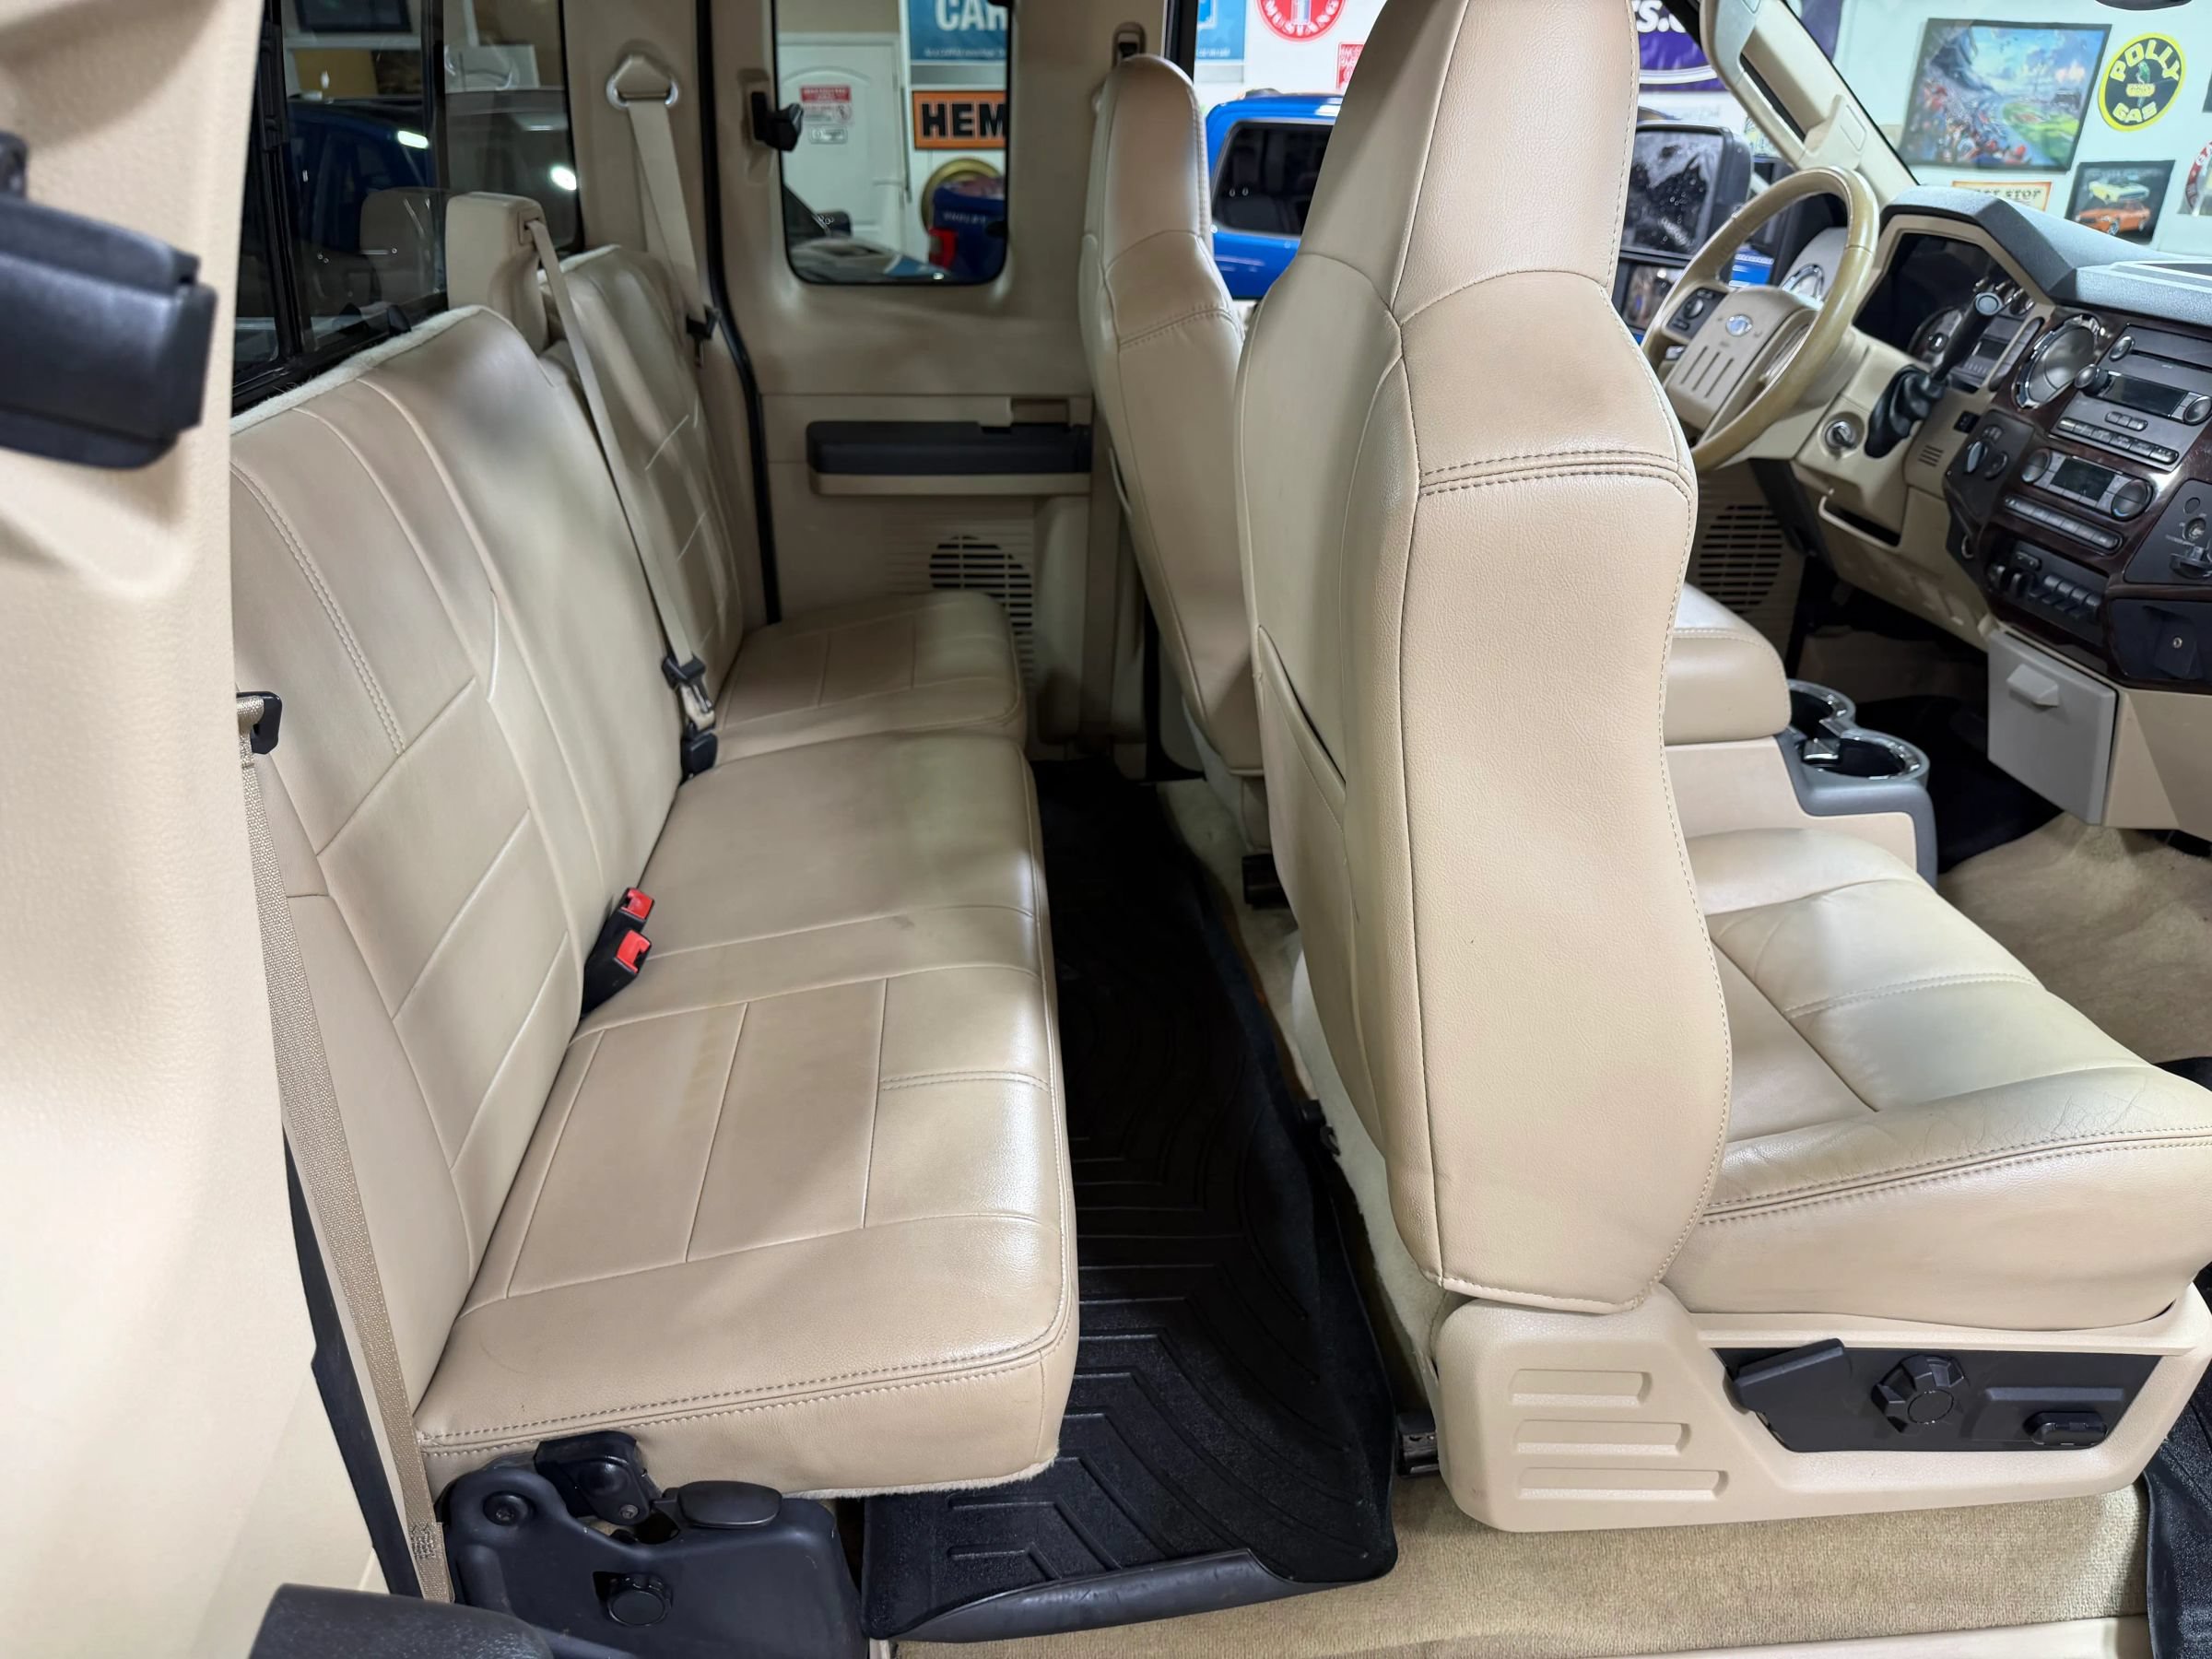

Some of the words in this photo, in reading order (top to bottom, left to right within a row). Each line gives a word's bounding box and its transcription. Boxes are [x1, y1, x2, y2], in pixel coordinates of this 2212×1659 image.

[2110, 39, 2180, 81] POLLY
[922, 103, 1006, 138] HEM
[2112, 100, 2158, 123] GAS
